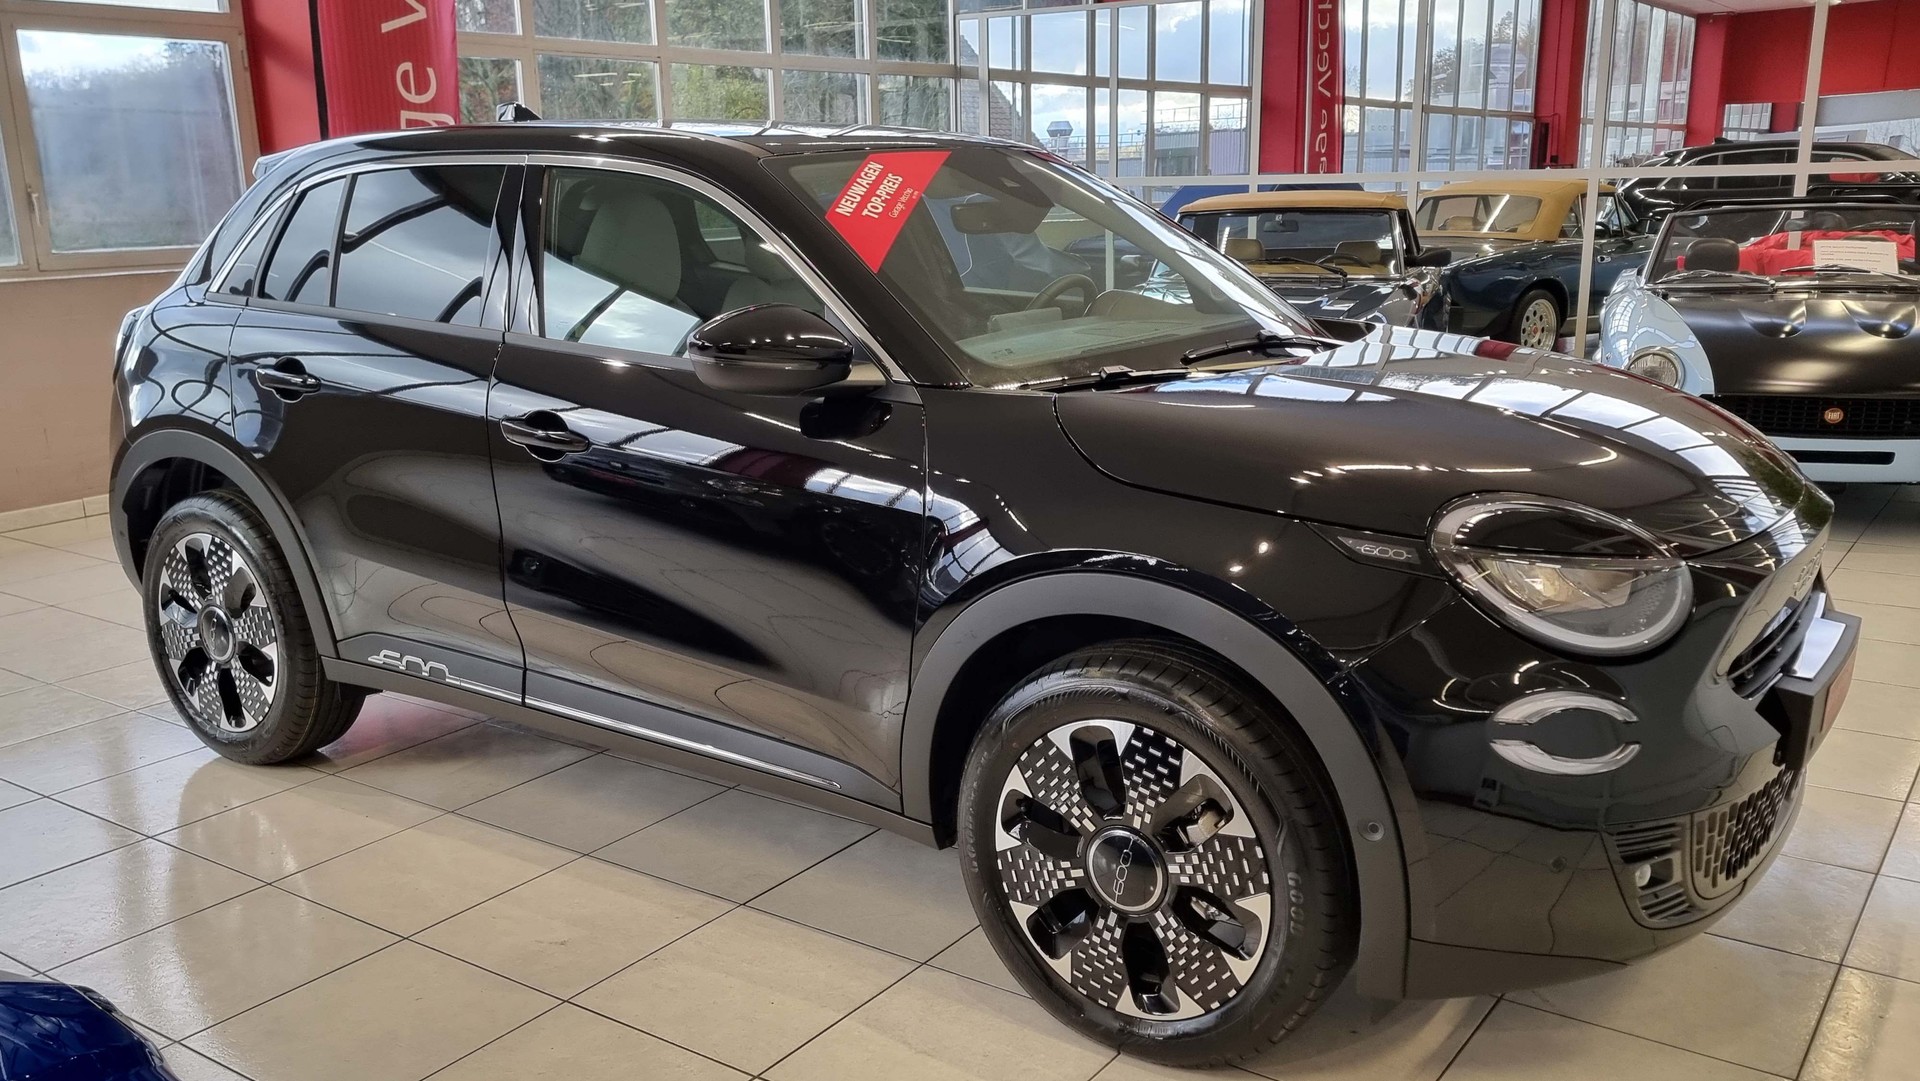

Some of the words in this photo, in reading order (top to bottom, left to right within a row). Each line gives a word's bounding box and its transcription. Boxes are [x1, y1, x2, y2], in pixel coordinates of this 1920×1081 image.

[835, 161, 884, 217] NEUWAGEN
[862, 173, 903, 219] TOP-PREIS
[888, 201, 906, 218] Garage
[1360, 543, 1408, 560] 600
[1112, 848, 1134, 896] 600
